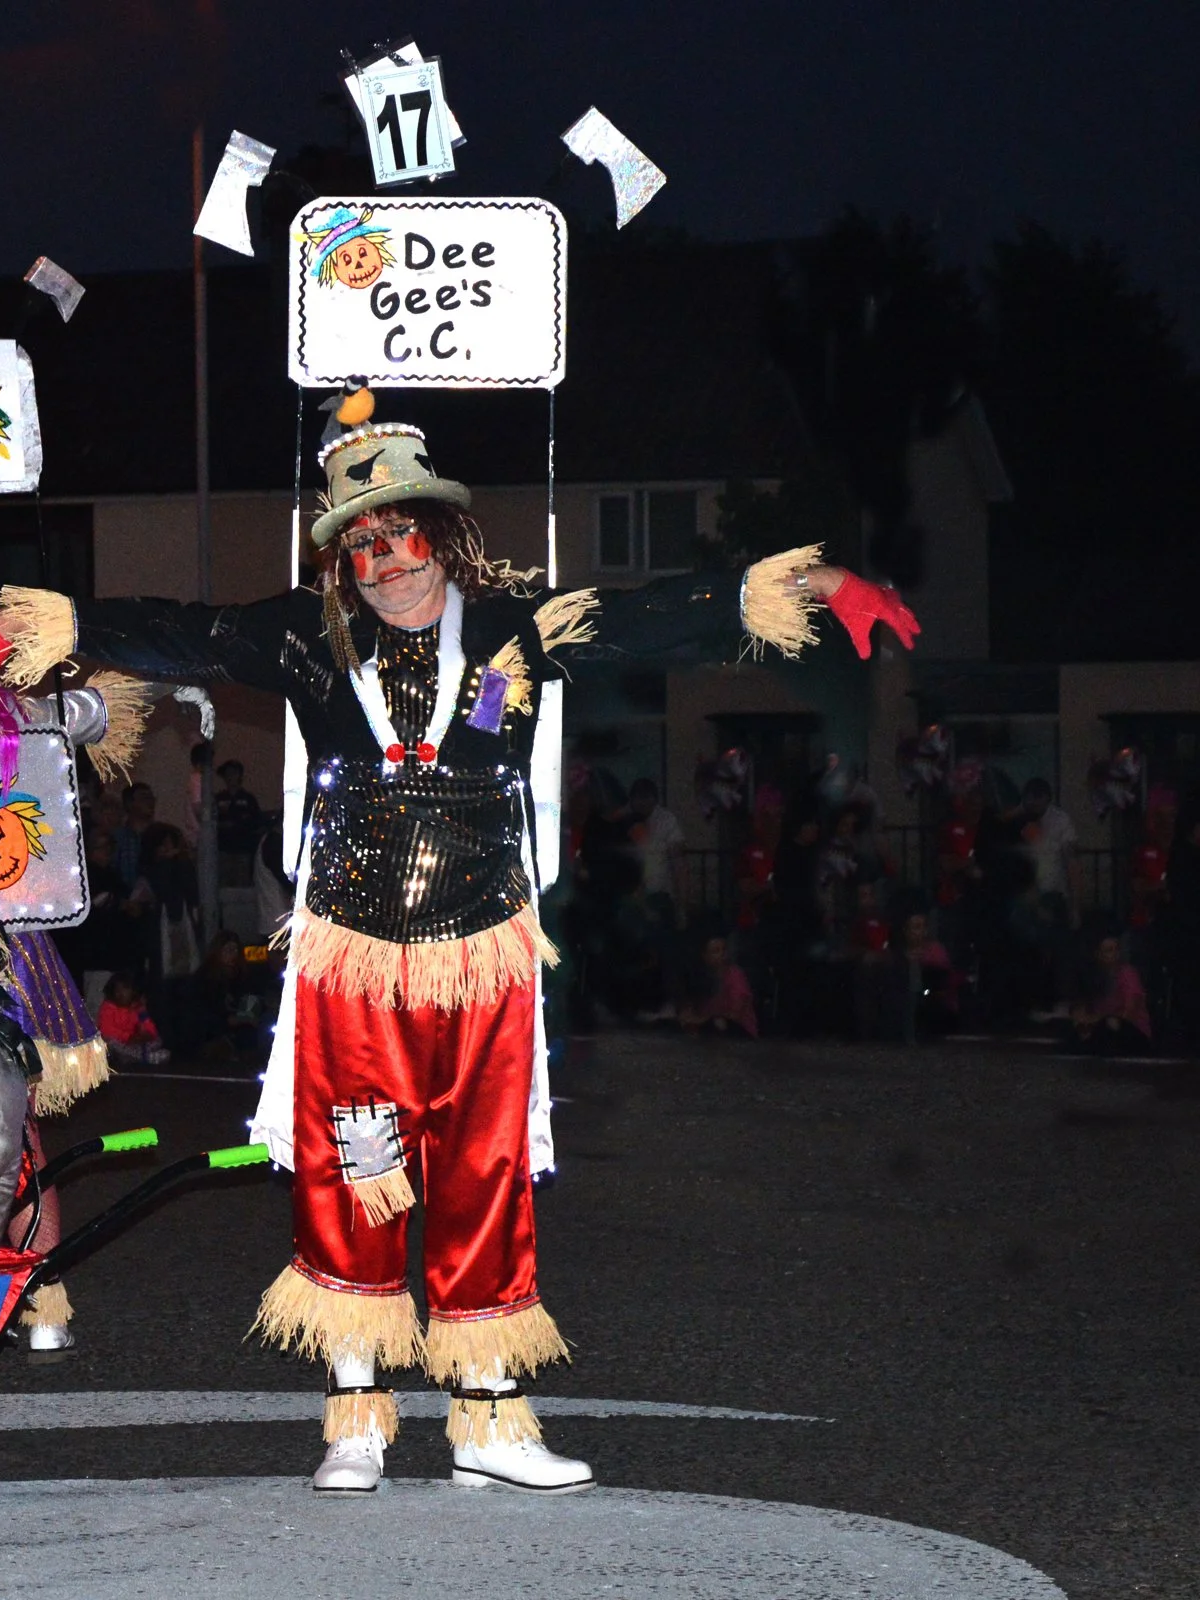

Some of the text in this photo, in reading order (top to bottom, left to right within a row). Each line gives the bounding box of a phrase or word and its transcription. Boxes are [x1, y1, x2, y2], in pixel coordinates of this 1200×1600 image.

[376, 89, 433, 170] 17
[404, 231, 496, 271] Dee
[370, 278, 493, 321] Gee's
[383, 320, 472, 363] C.C.
